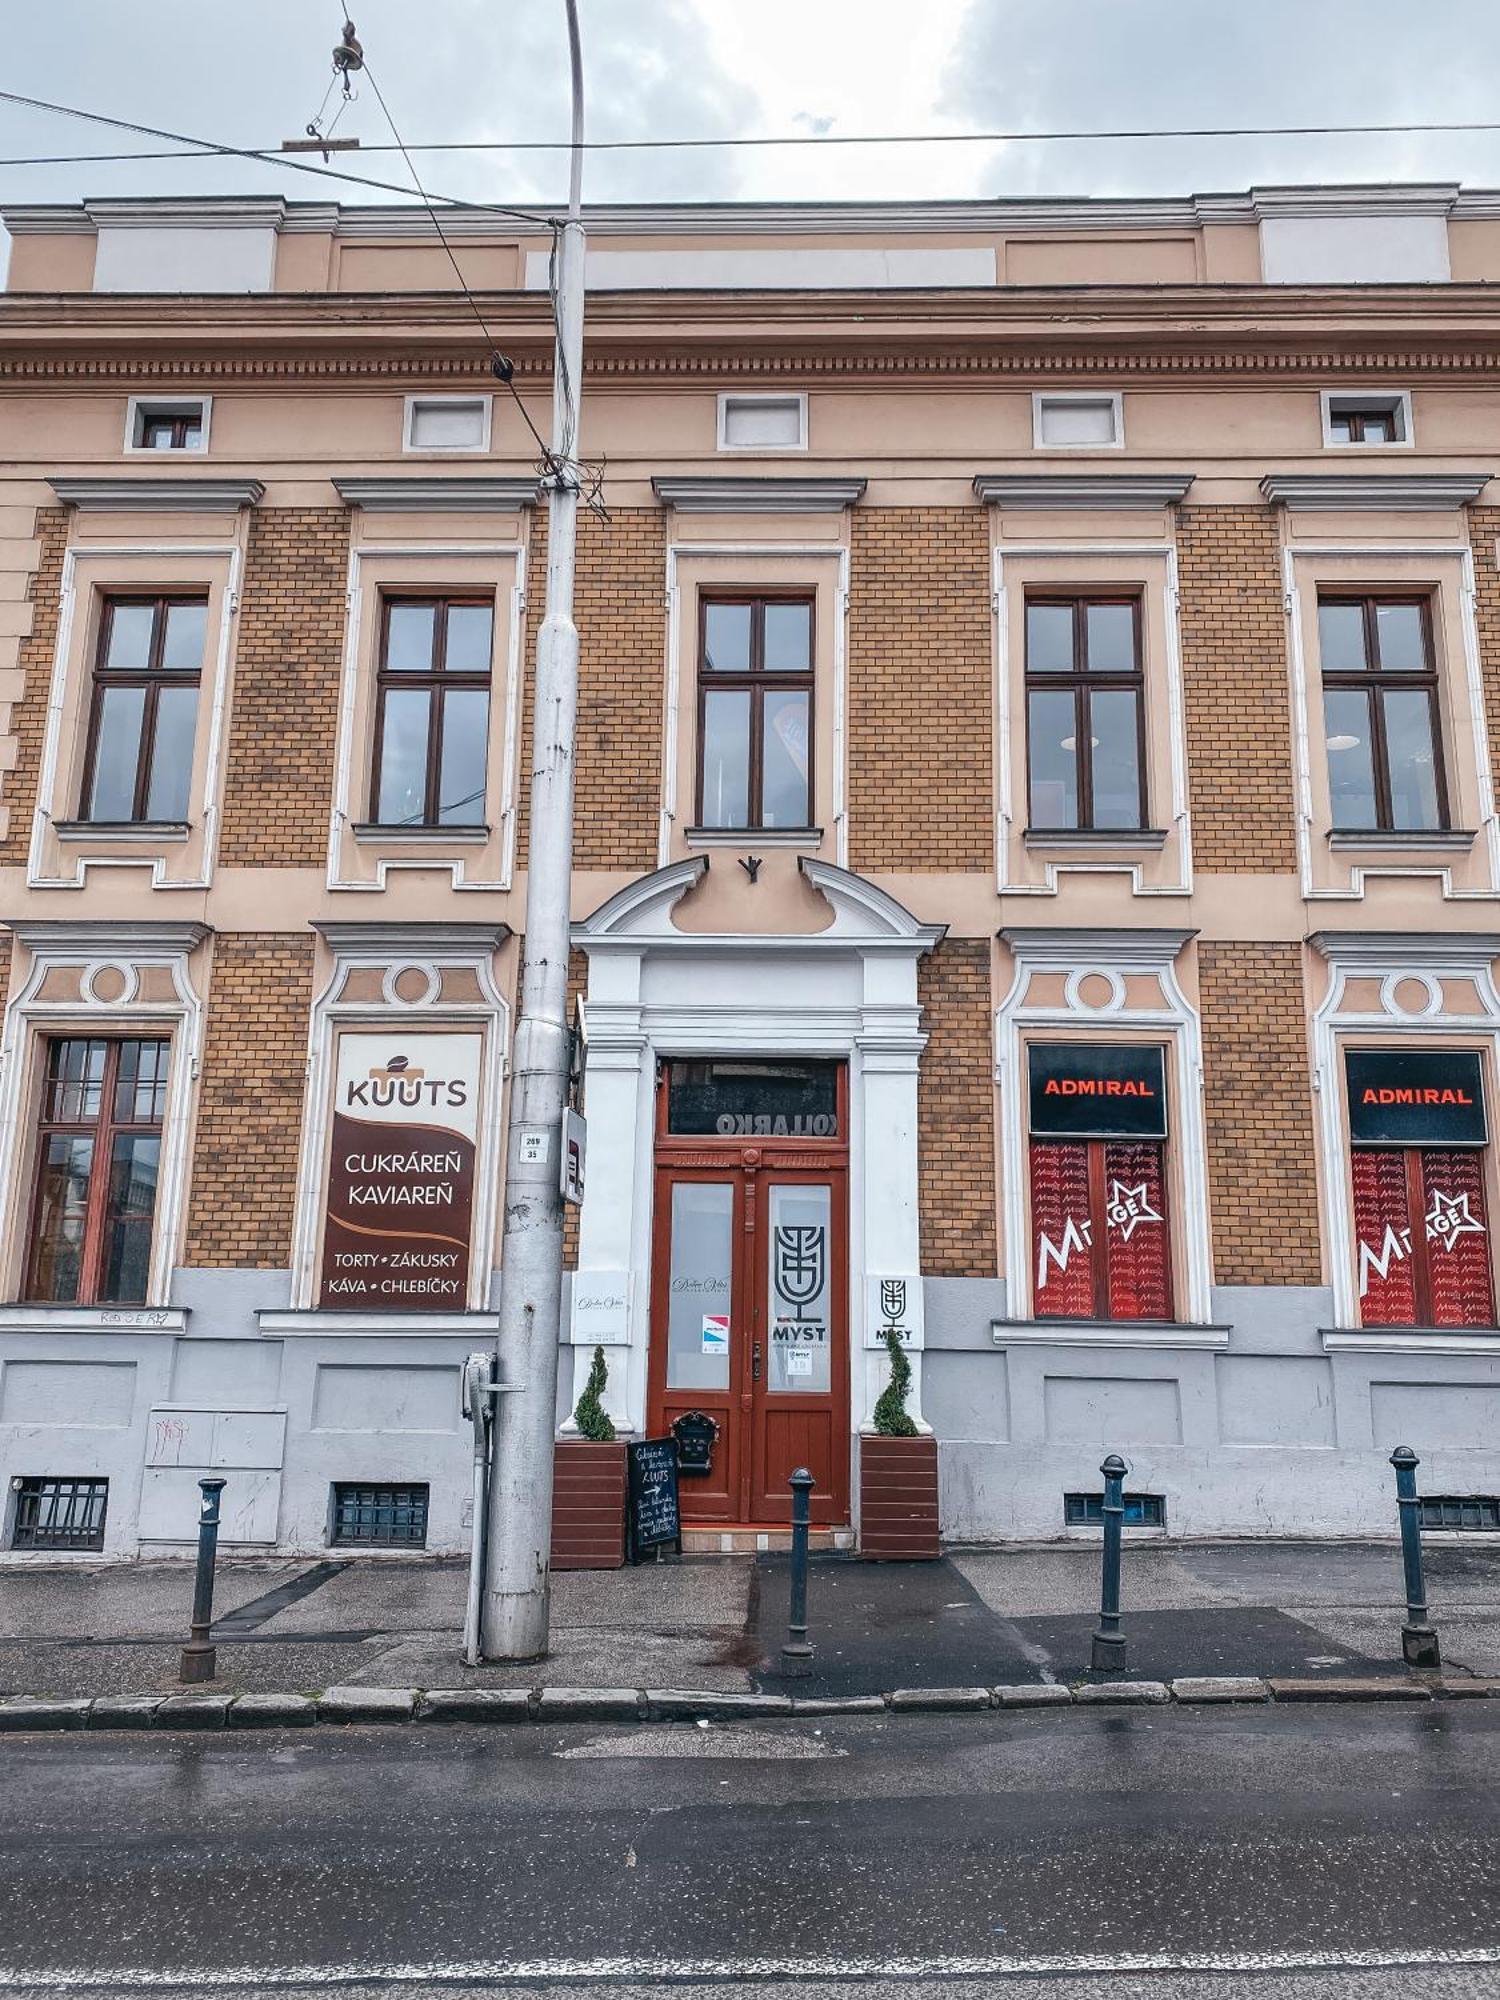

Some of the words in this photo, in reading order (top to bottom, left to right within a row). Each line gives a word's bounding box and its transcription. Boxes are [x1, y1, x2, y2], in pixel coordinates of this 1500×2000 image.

[347, 1079, 467, 1107] KUUTS
[1044, 1079, 1154, 1096] ADMIRAL
[1362, 1088, 1473, 1104] ADMIRAL
[344, 1150, 461, 1173] CUKRÁREŇ
[348, 1182, 453, 1205] KAVIAREŇ
[334, 1253, 379, 1268] TORTY
[390, 1251, 459, 1268] ZÁKUSKY
[328, 1276, 367, 1293] KÁVA
[380, 1276, 460, 1293] CHLEBÍČKY
[773, 1326, 826, 1341] MYST
[876, 1330, 912, 1341] MST
